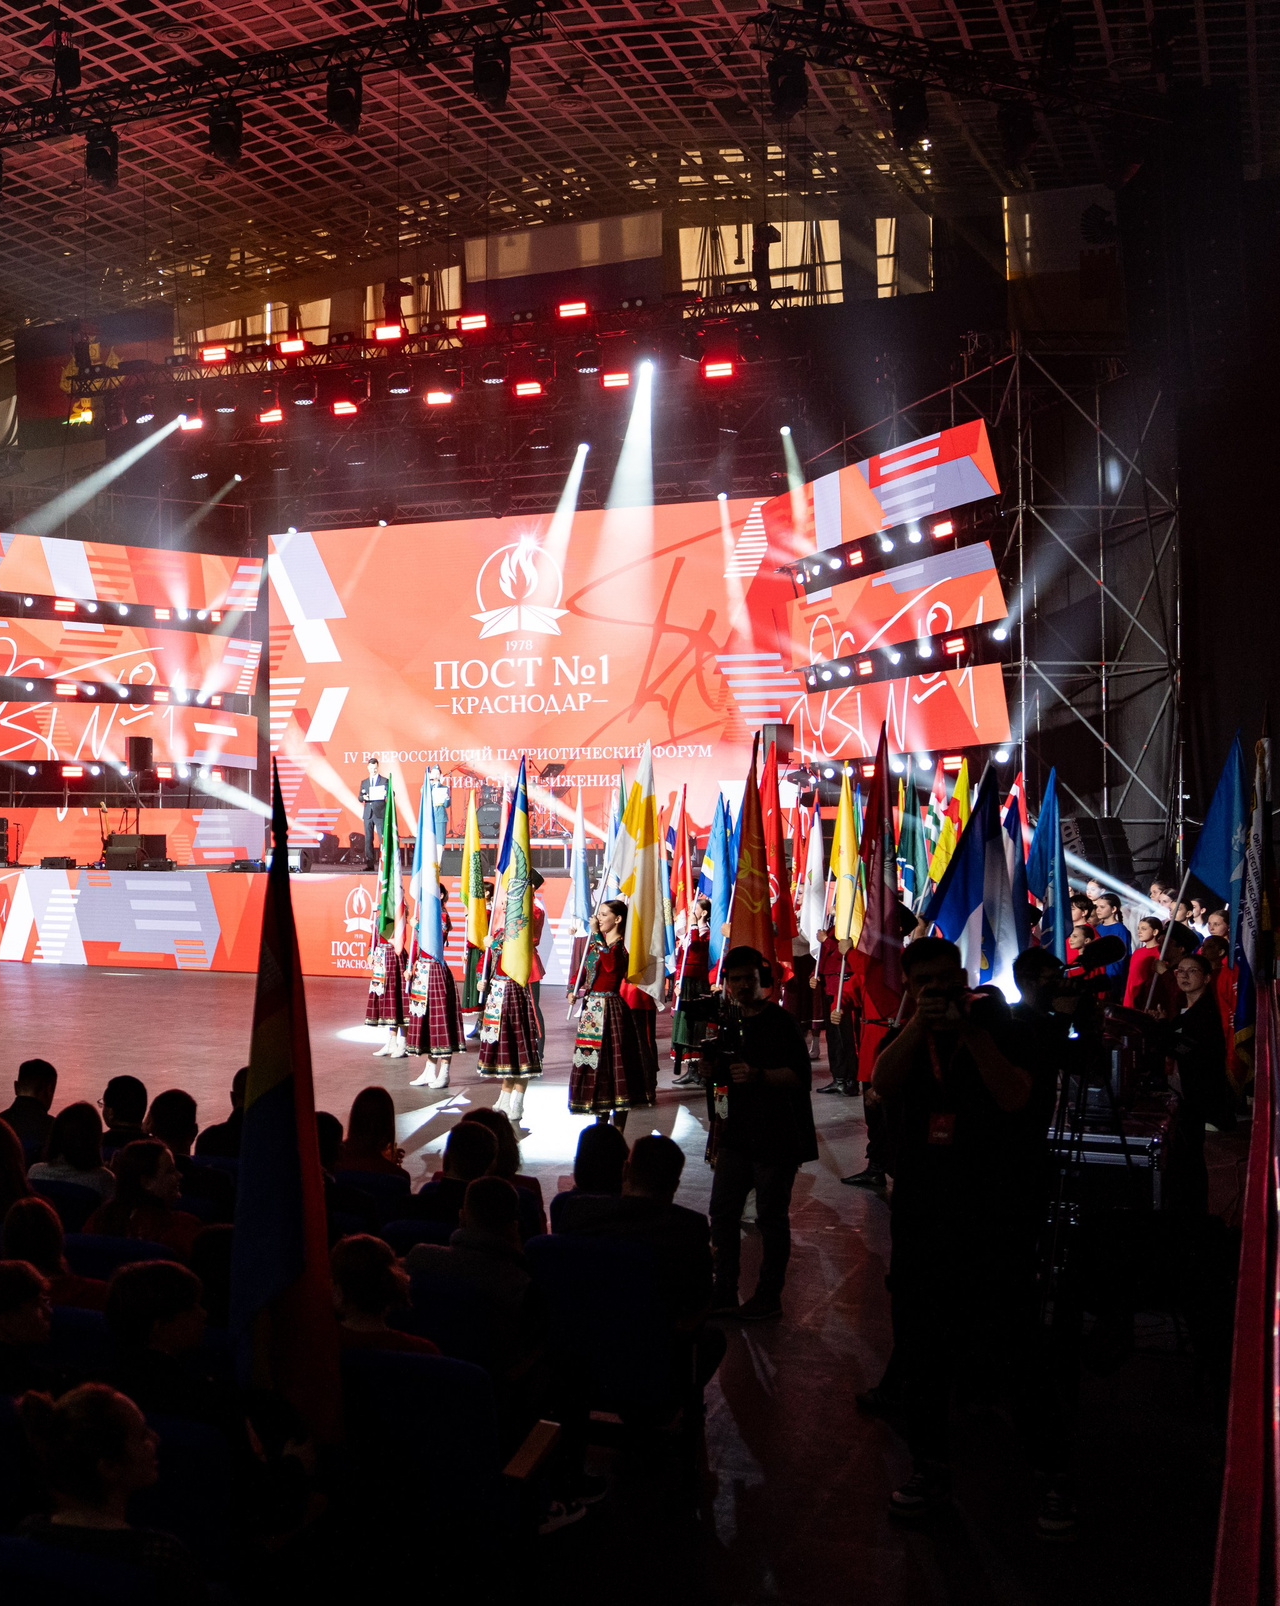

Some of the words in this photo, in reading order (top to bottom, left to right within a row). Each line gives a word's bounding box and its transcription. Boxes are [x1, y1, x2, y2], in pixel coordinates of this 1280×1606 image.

[506, 640, 533, 651] 1978
[434, 657, 542, 690] ПОСТ
[344, 751, 358, 763] IV
[362, 746, 492, 763] ВСЕРОССИЙСКИЙ
[497, 743, 646, 761] ПАТРИОТИЧЕСКИЙ
[652, 744, 712, 758] ФОРУМ
[331, 941, 366, 957] ПОСТ
[336, 959, 373, 970] КРАСНОД
